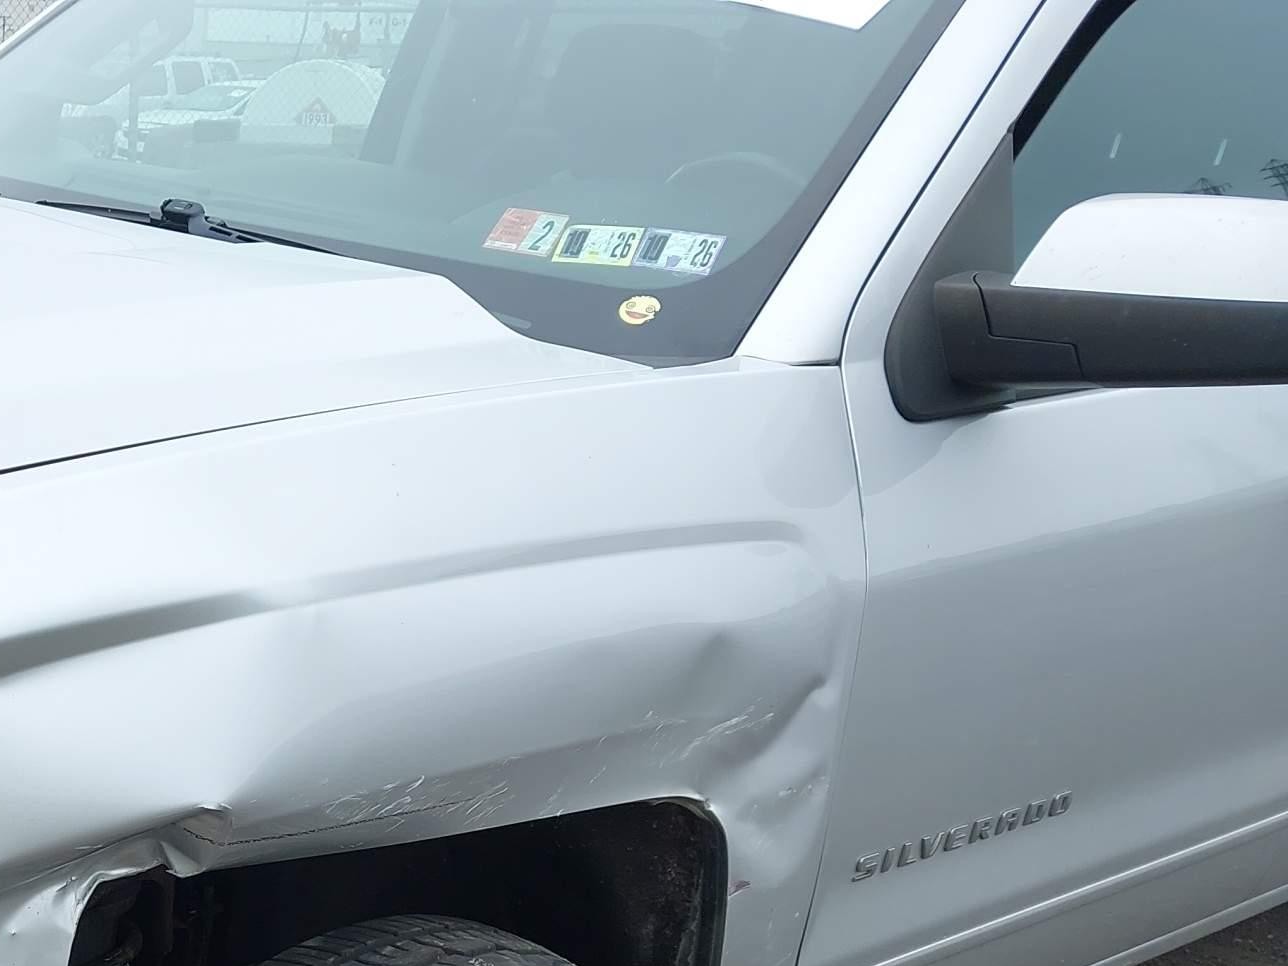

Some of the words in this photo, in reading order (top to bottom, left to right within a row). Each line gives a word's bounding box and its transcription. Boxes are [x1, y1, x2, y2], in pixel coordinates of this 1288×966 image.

[527, 220, 556, 251] 2
[610, 231, 637, 259] 26
[641, 233, 670, 262] 10
[690, 238, 719, 268] 26
[851, 790, 1073, 882] SILVERADO
